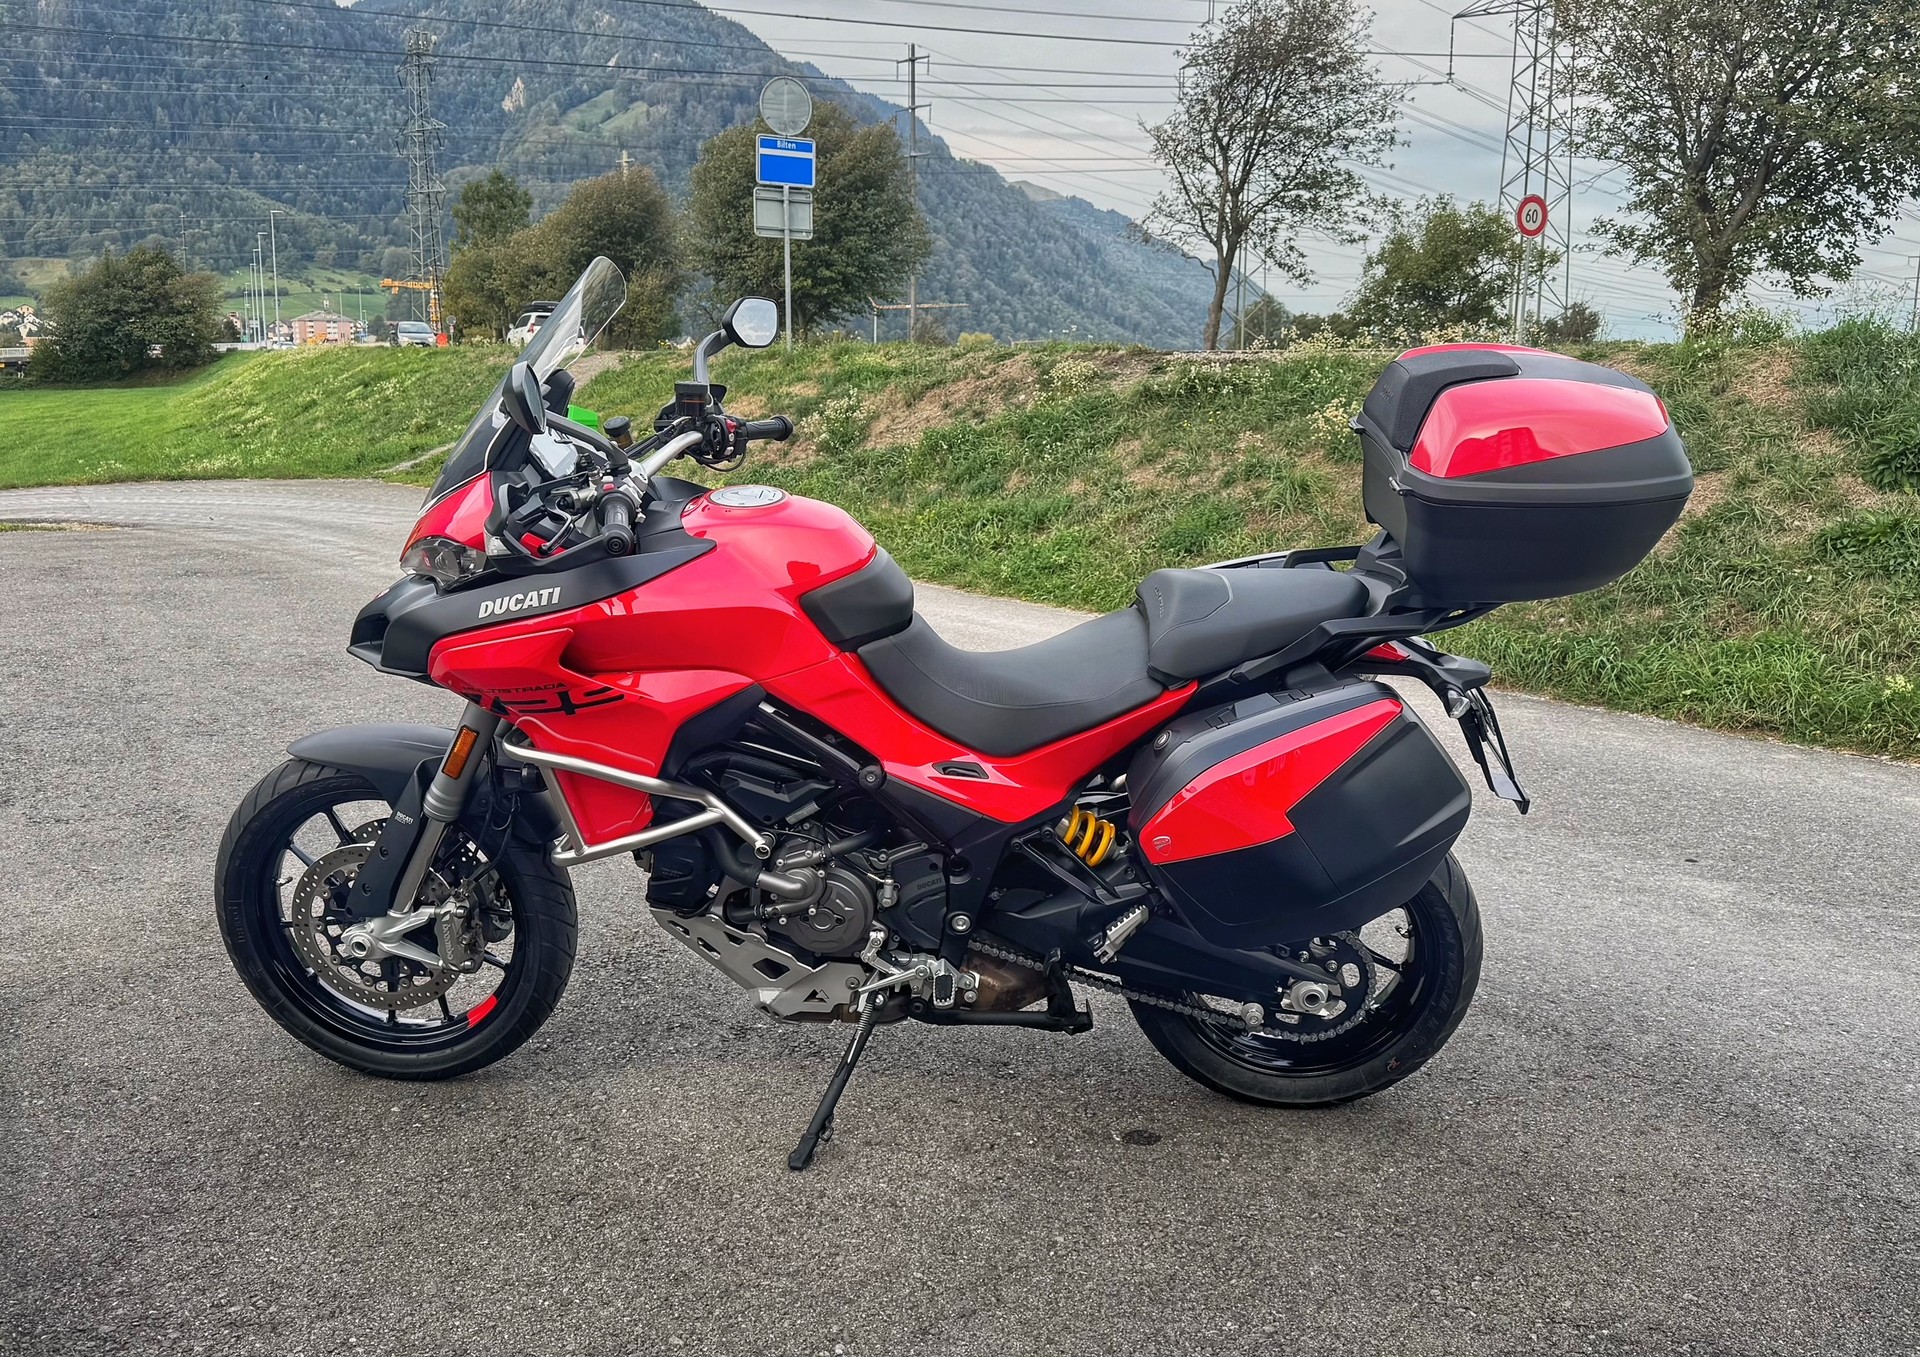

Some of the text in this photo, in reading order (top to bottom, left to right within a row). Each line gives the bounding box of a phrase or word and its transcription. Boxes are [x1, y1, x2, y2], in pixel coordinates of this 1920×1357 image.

[776, 140, 797, 149] Bilten
[1525, 209, 1538, 223] 60
[478, 586, 561, 619] DUCATI
[917, 877, 942, 890] DUCATI
